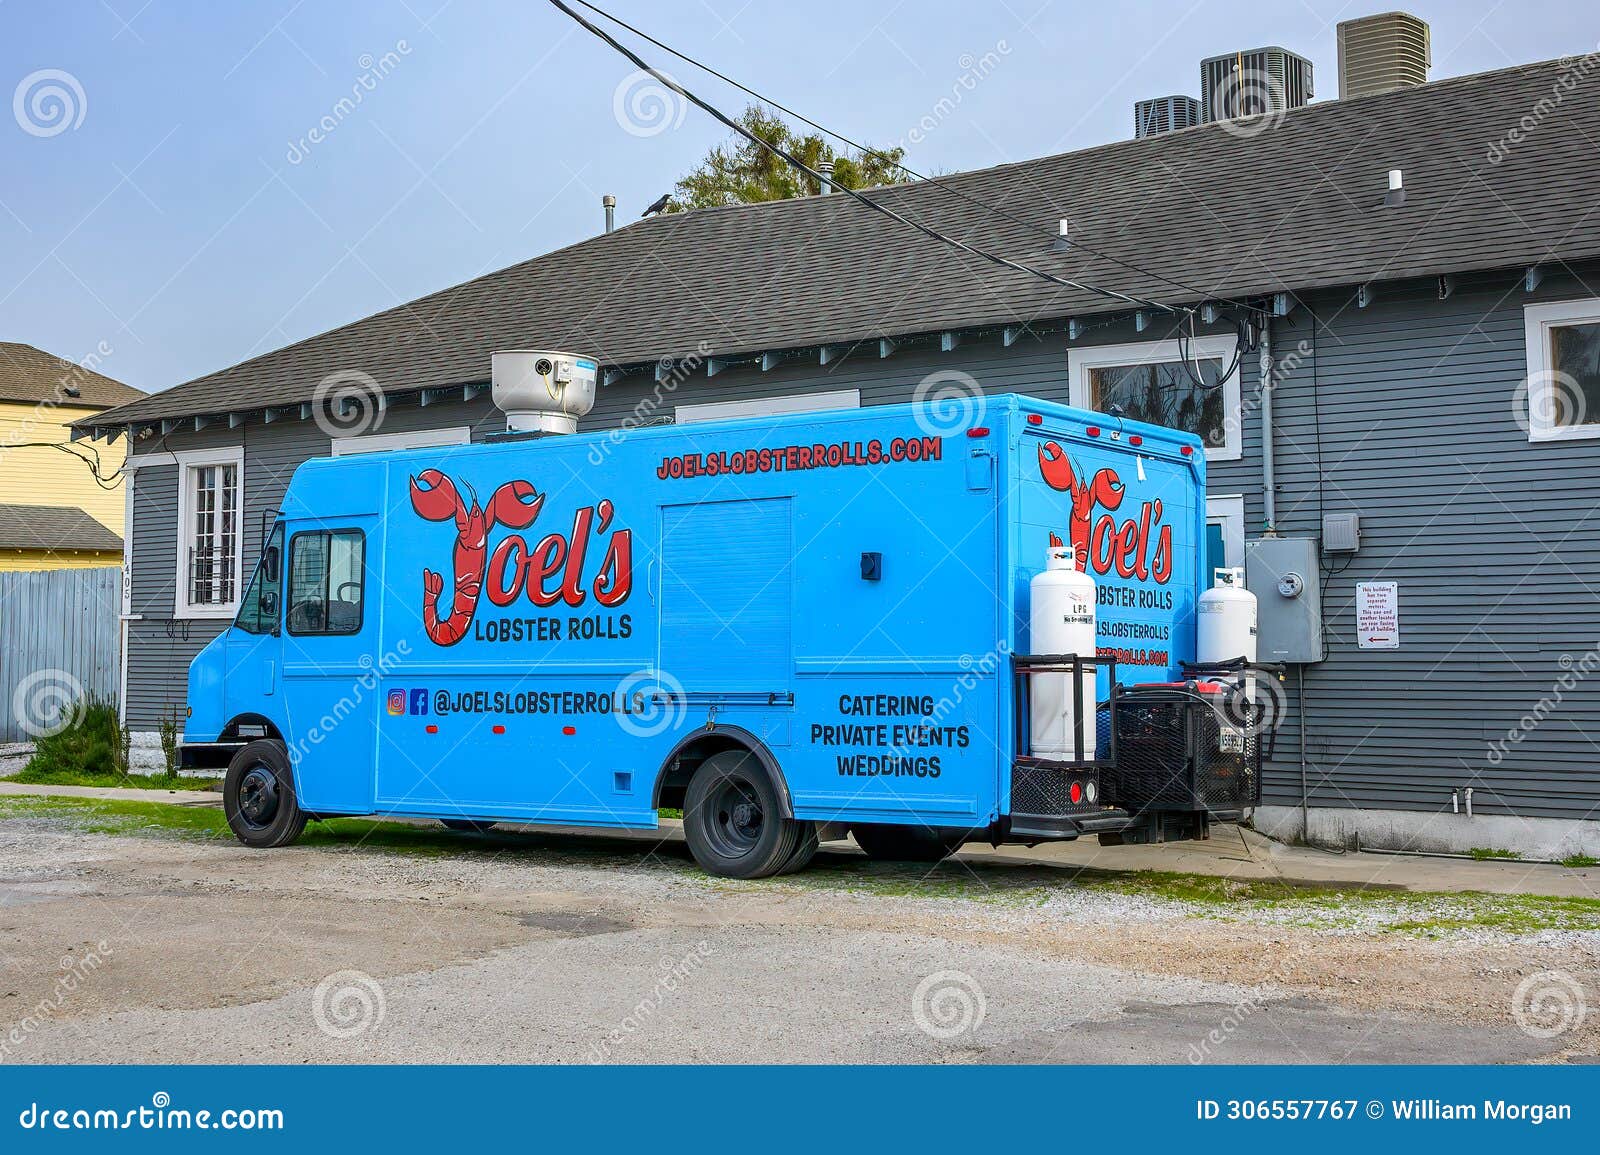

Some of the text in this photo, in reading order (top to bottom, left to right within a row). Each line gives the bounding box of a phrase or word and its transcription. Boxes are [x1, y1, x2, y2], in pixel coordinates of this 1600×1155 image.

[657, 436, 942, 480] JOELSLOBSTERROLLS.COM
[1095, 585, 1136, 608] BSTER
[1139, 589, 1172, 610] ROLLS
[475, 614, 632, 642] LOBSTER ROLLS
[1096, 620, 1169, 641] LSLOBSTERROLLS
[434, 689, 645, 716] @JOELSLOBSTERROLLS
[839, 694, 934, 717] CATERING
[811, 724, 970, 748] PRIVATE EVENTS
[837, 755, 941, 778] WEDDINGS
